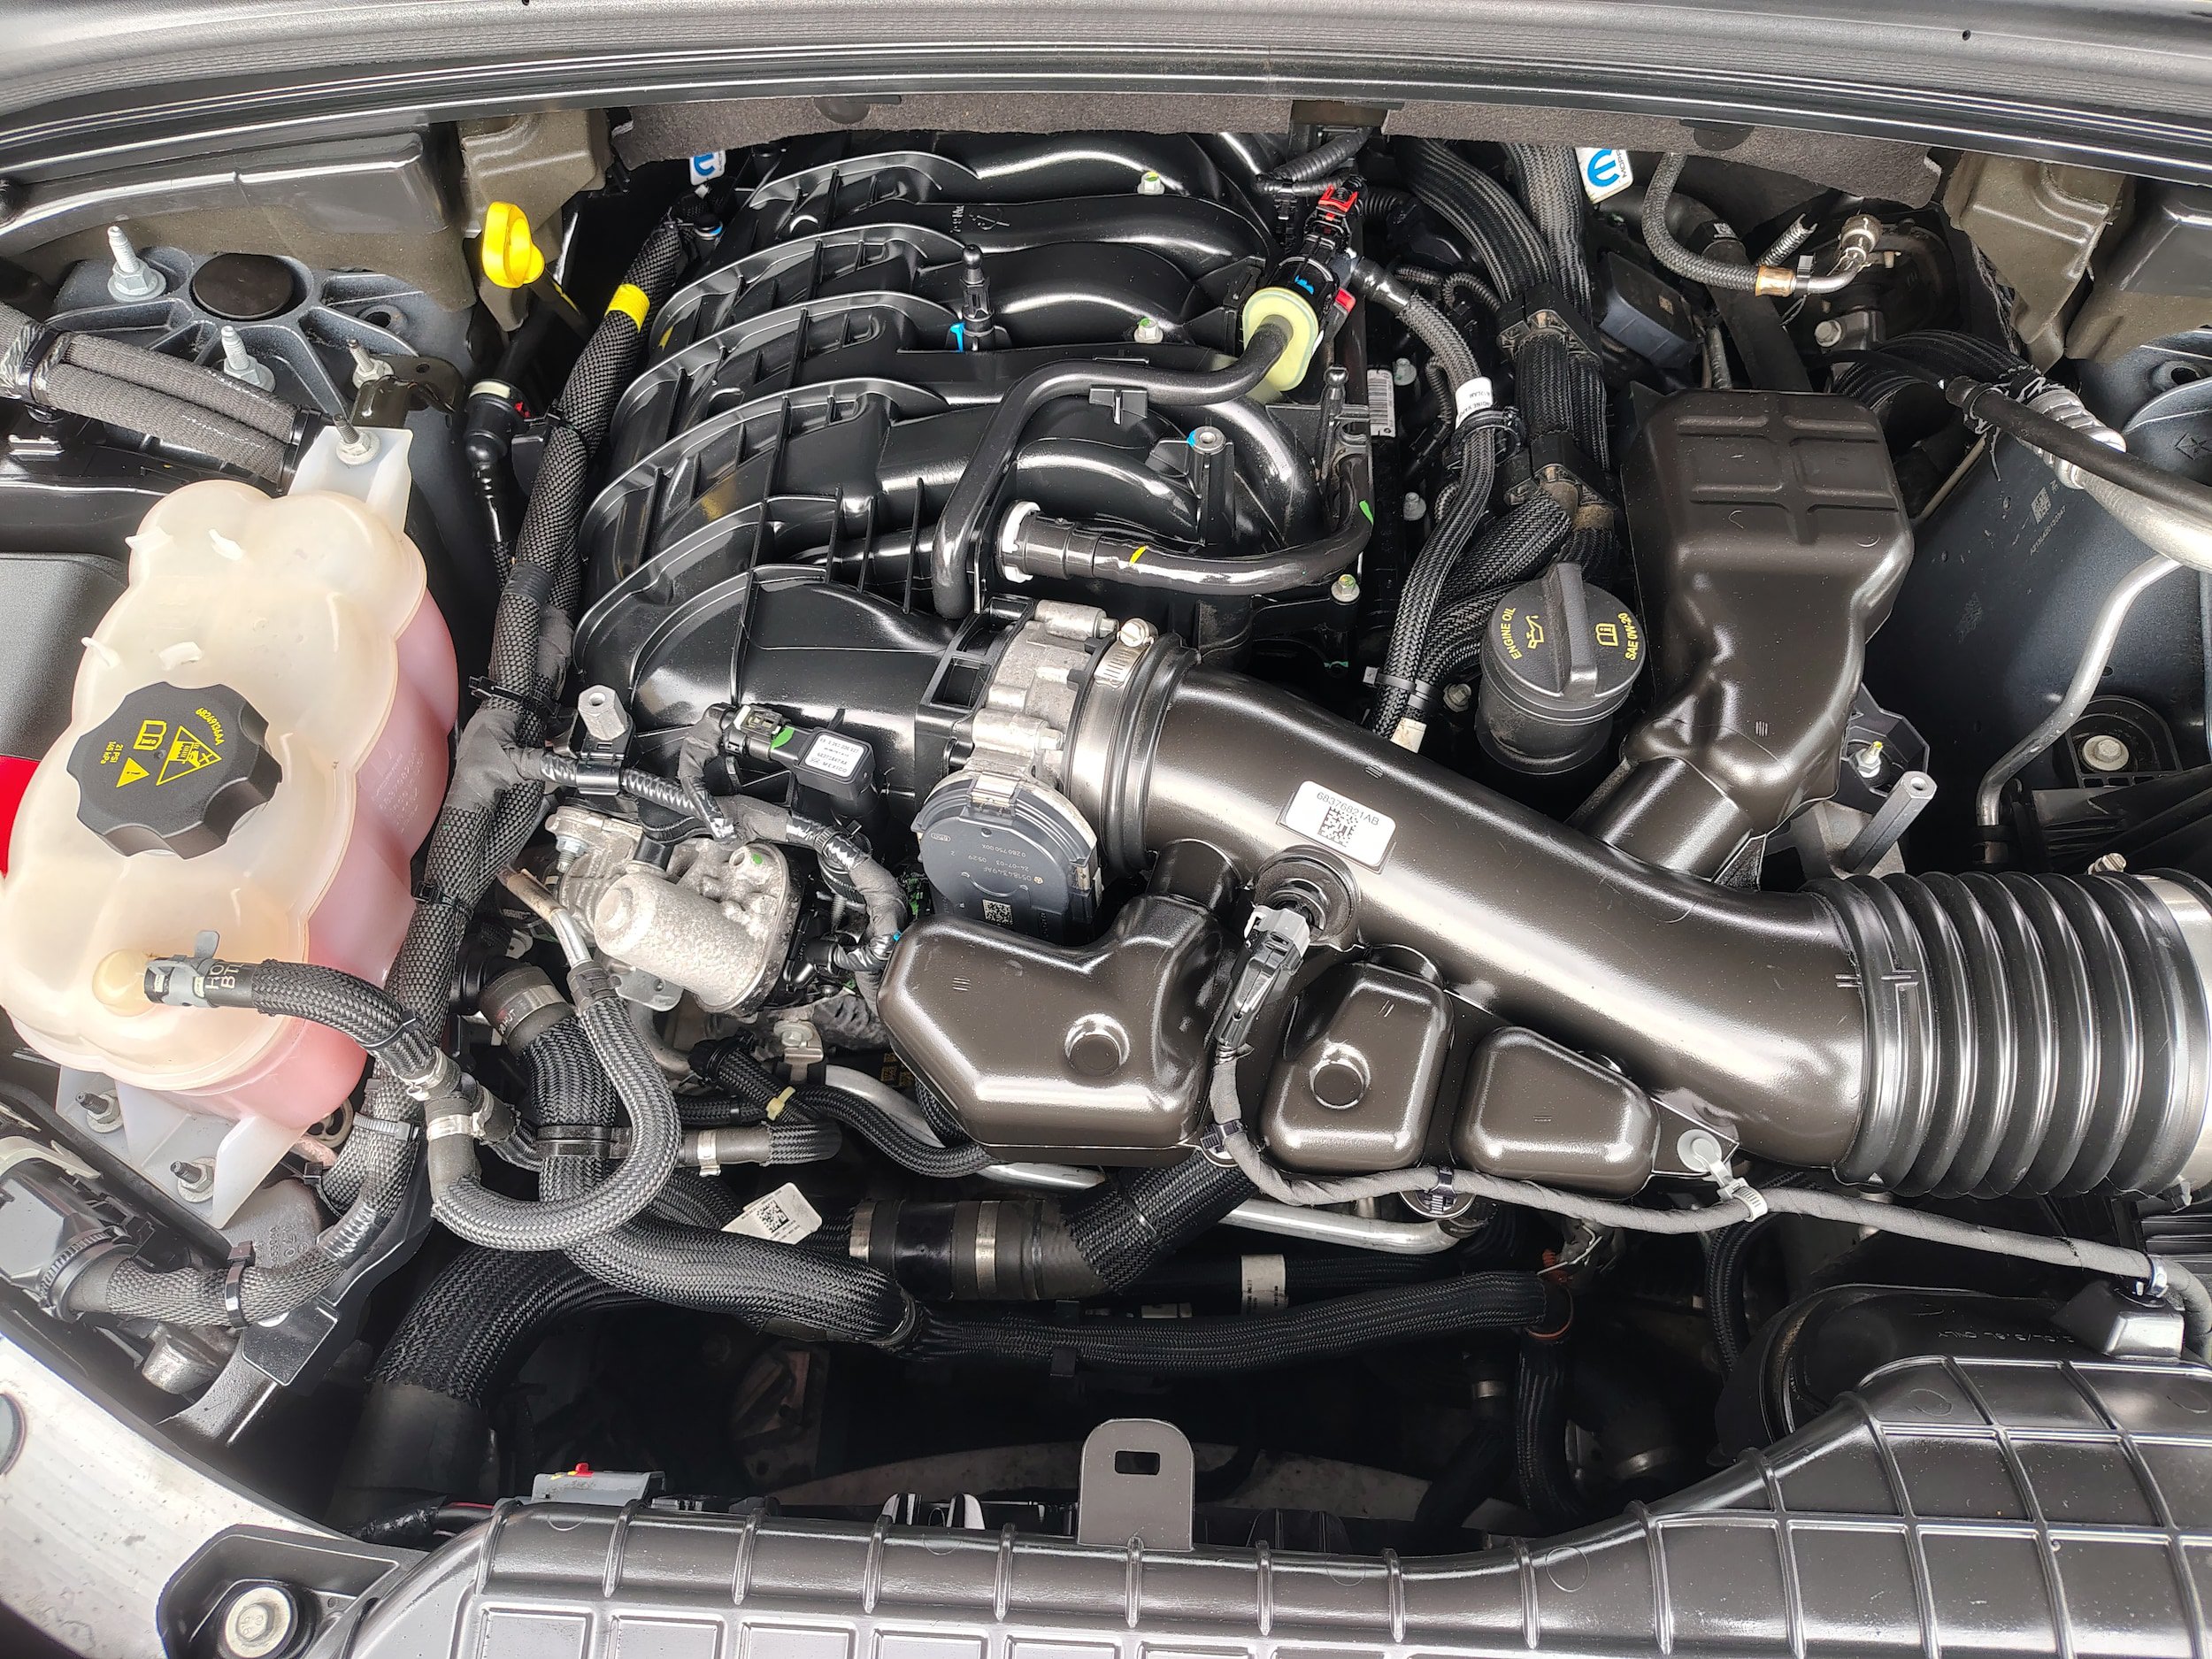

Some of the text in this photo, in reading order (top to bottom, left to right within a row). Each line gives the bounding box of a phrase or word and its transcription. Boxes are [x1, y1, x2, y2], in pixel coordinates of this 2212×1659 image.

[1501, 607, 1523, 660] ENGINE OIL
[1617, 612, 1640, 661] SAE 0W-20
[196, 707, 226, 746] 68249136AA
[100, 741, 117, 764] 145 kPa
[109, 751, 121, 763] PSI
[1317, 791, 1379, 826] 68376821AB
